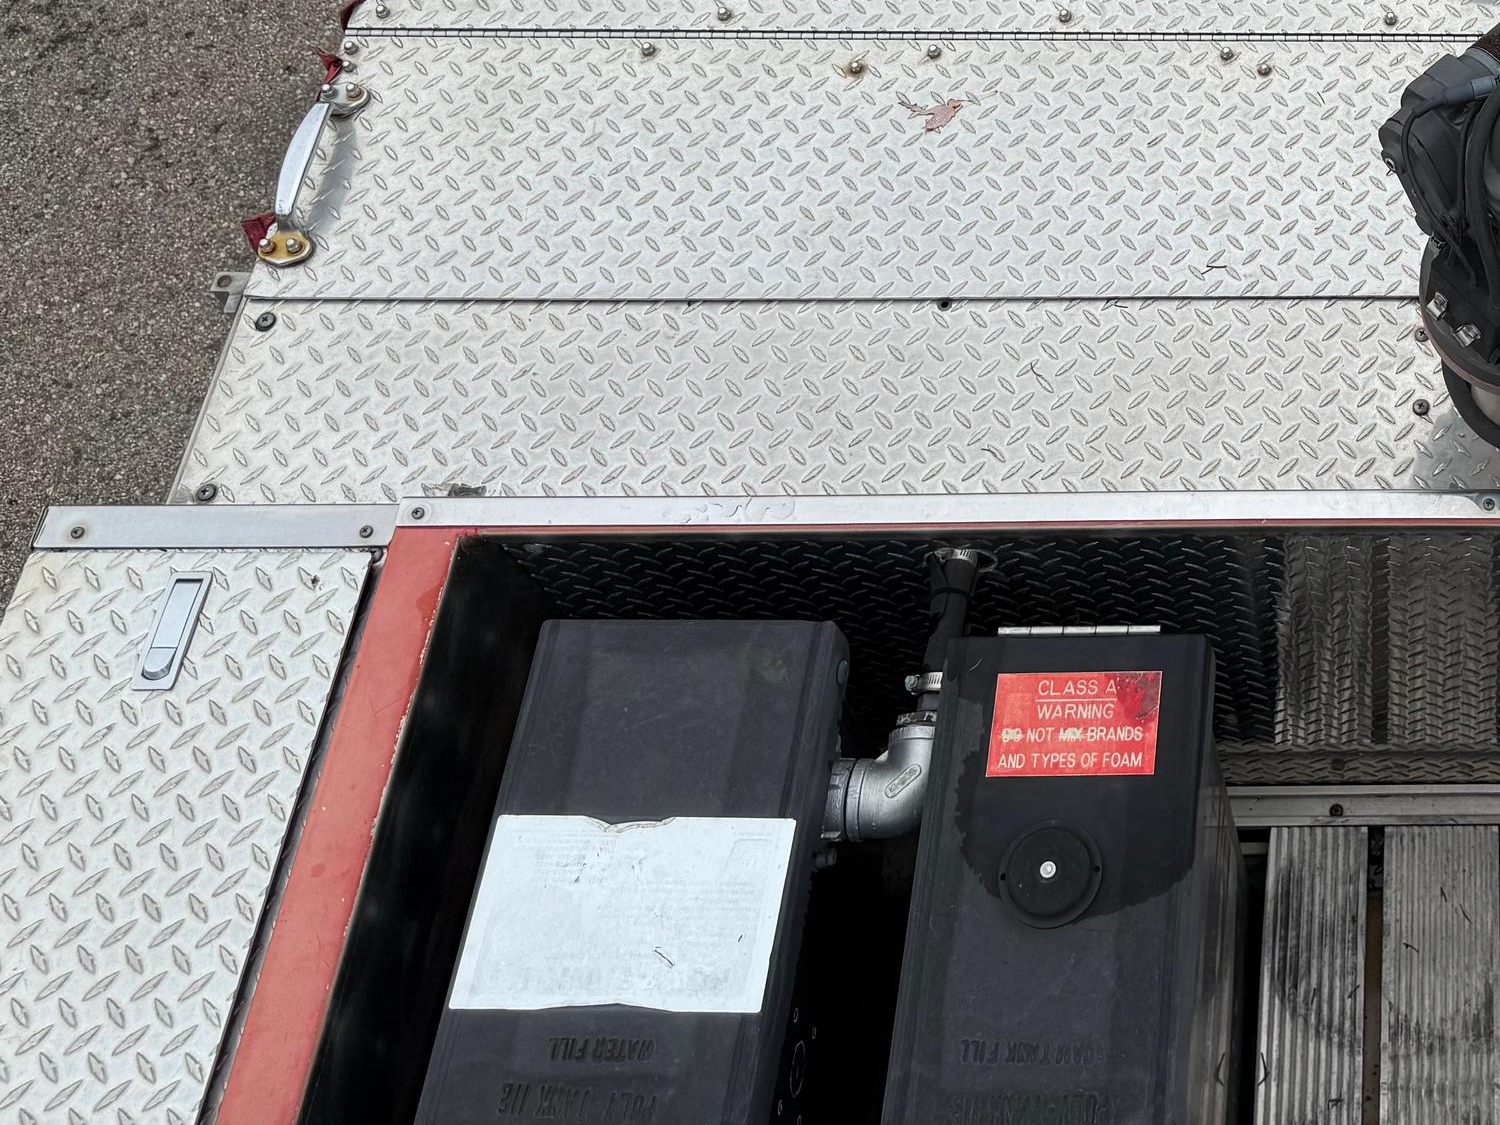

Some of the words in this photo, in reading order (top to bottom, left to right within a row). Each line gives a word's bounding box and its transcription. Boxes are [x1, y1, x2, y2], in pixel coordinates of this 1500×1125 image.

[1038, 679, 1099, 696] CLASS
[1105, 681, 1117, 694] A
[1037, 704, 1114, 720] WARNING
[1001, 728, 1022, 743] DO
[1026, 727, 1054, 742] NOT
[1059, 727, 1083, 742] MIX
[1087, 726, 1143, 742] BRANDS
[998, 754, 1025, 768] AND
[1032, 753, 1076, 768] TYPES
[1081, 752, 1099, 768] OF
[1102, 752, 1142, 768] FOAM
[548, 1037, 589, 1063] FILL
[592, 1037, 655, 1064] WATER
[960, 1038, 1001, 1064] FILL
[1005, 1041, 1051, 1066] TANK
